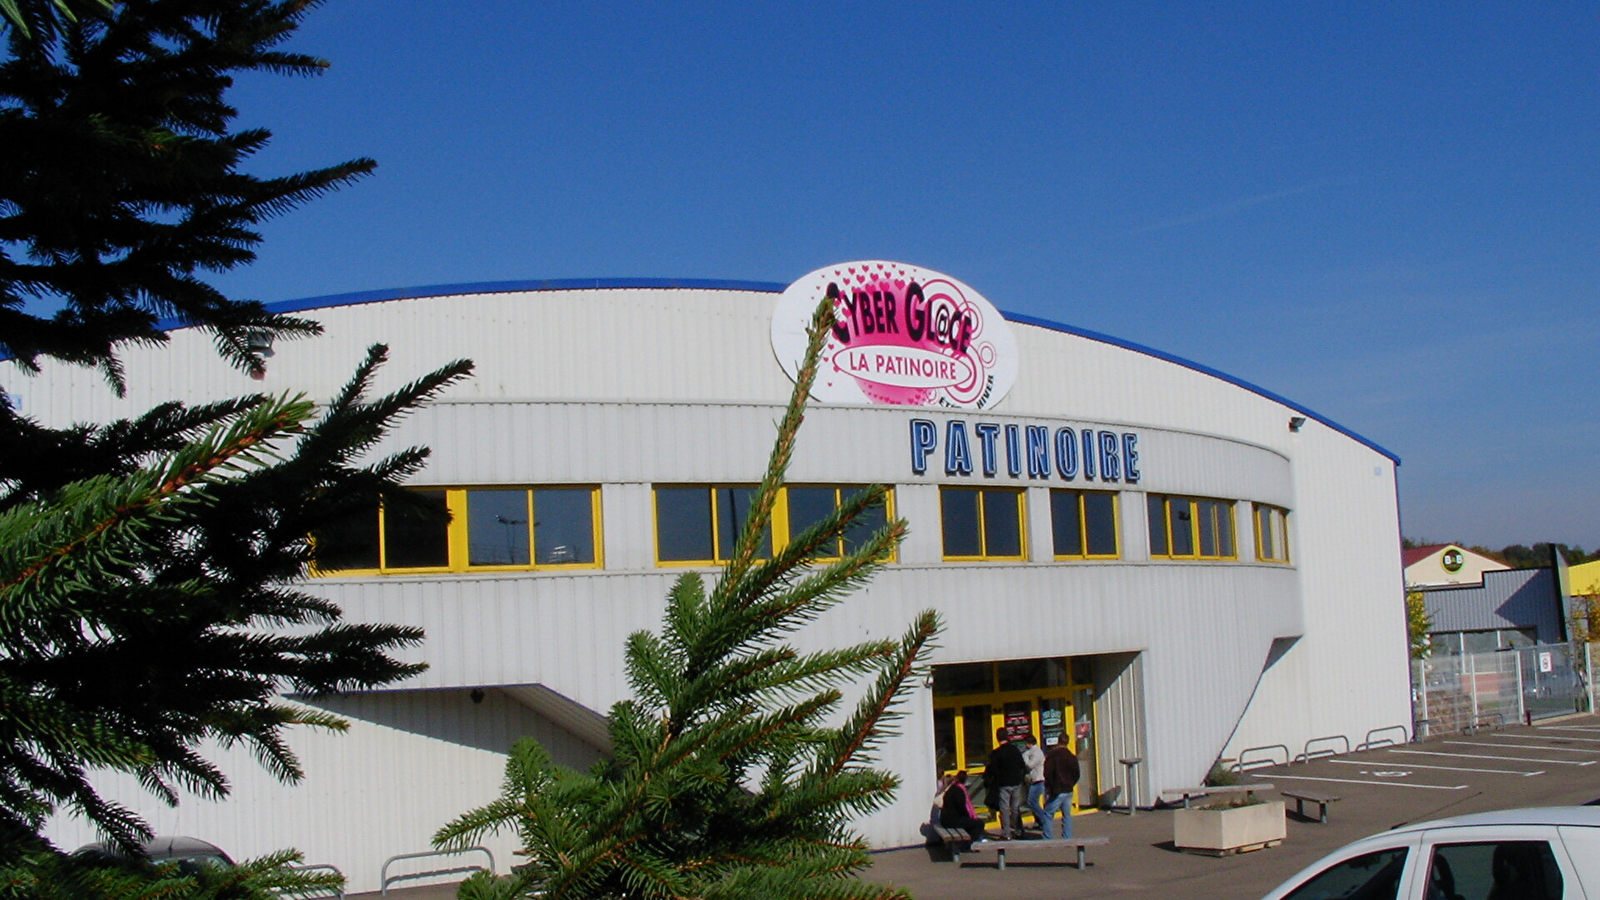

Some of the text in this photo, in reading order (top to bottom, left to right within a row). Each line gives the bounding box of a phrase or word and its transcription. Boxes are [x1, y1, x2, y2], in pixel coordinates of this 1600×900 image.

[826, 281, 900, 344] CYBER
[849, 352, 957, 380] LA PATINOIRE
[976, 374, 995, 410] HIVER
[909, 418, 1141, 483] PATINOIRE
